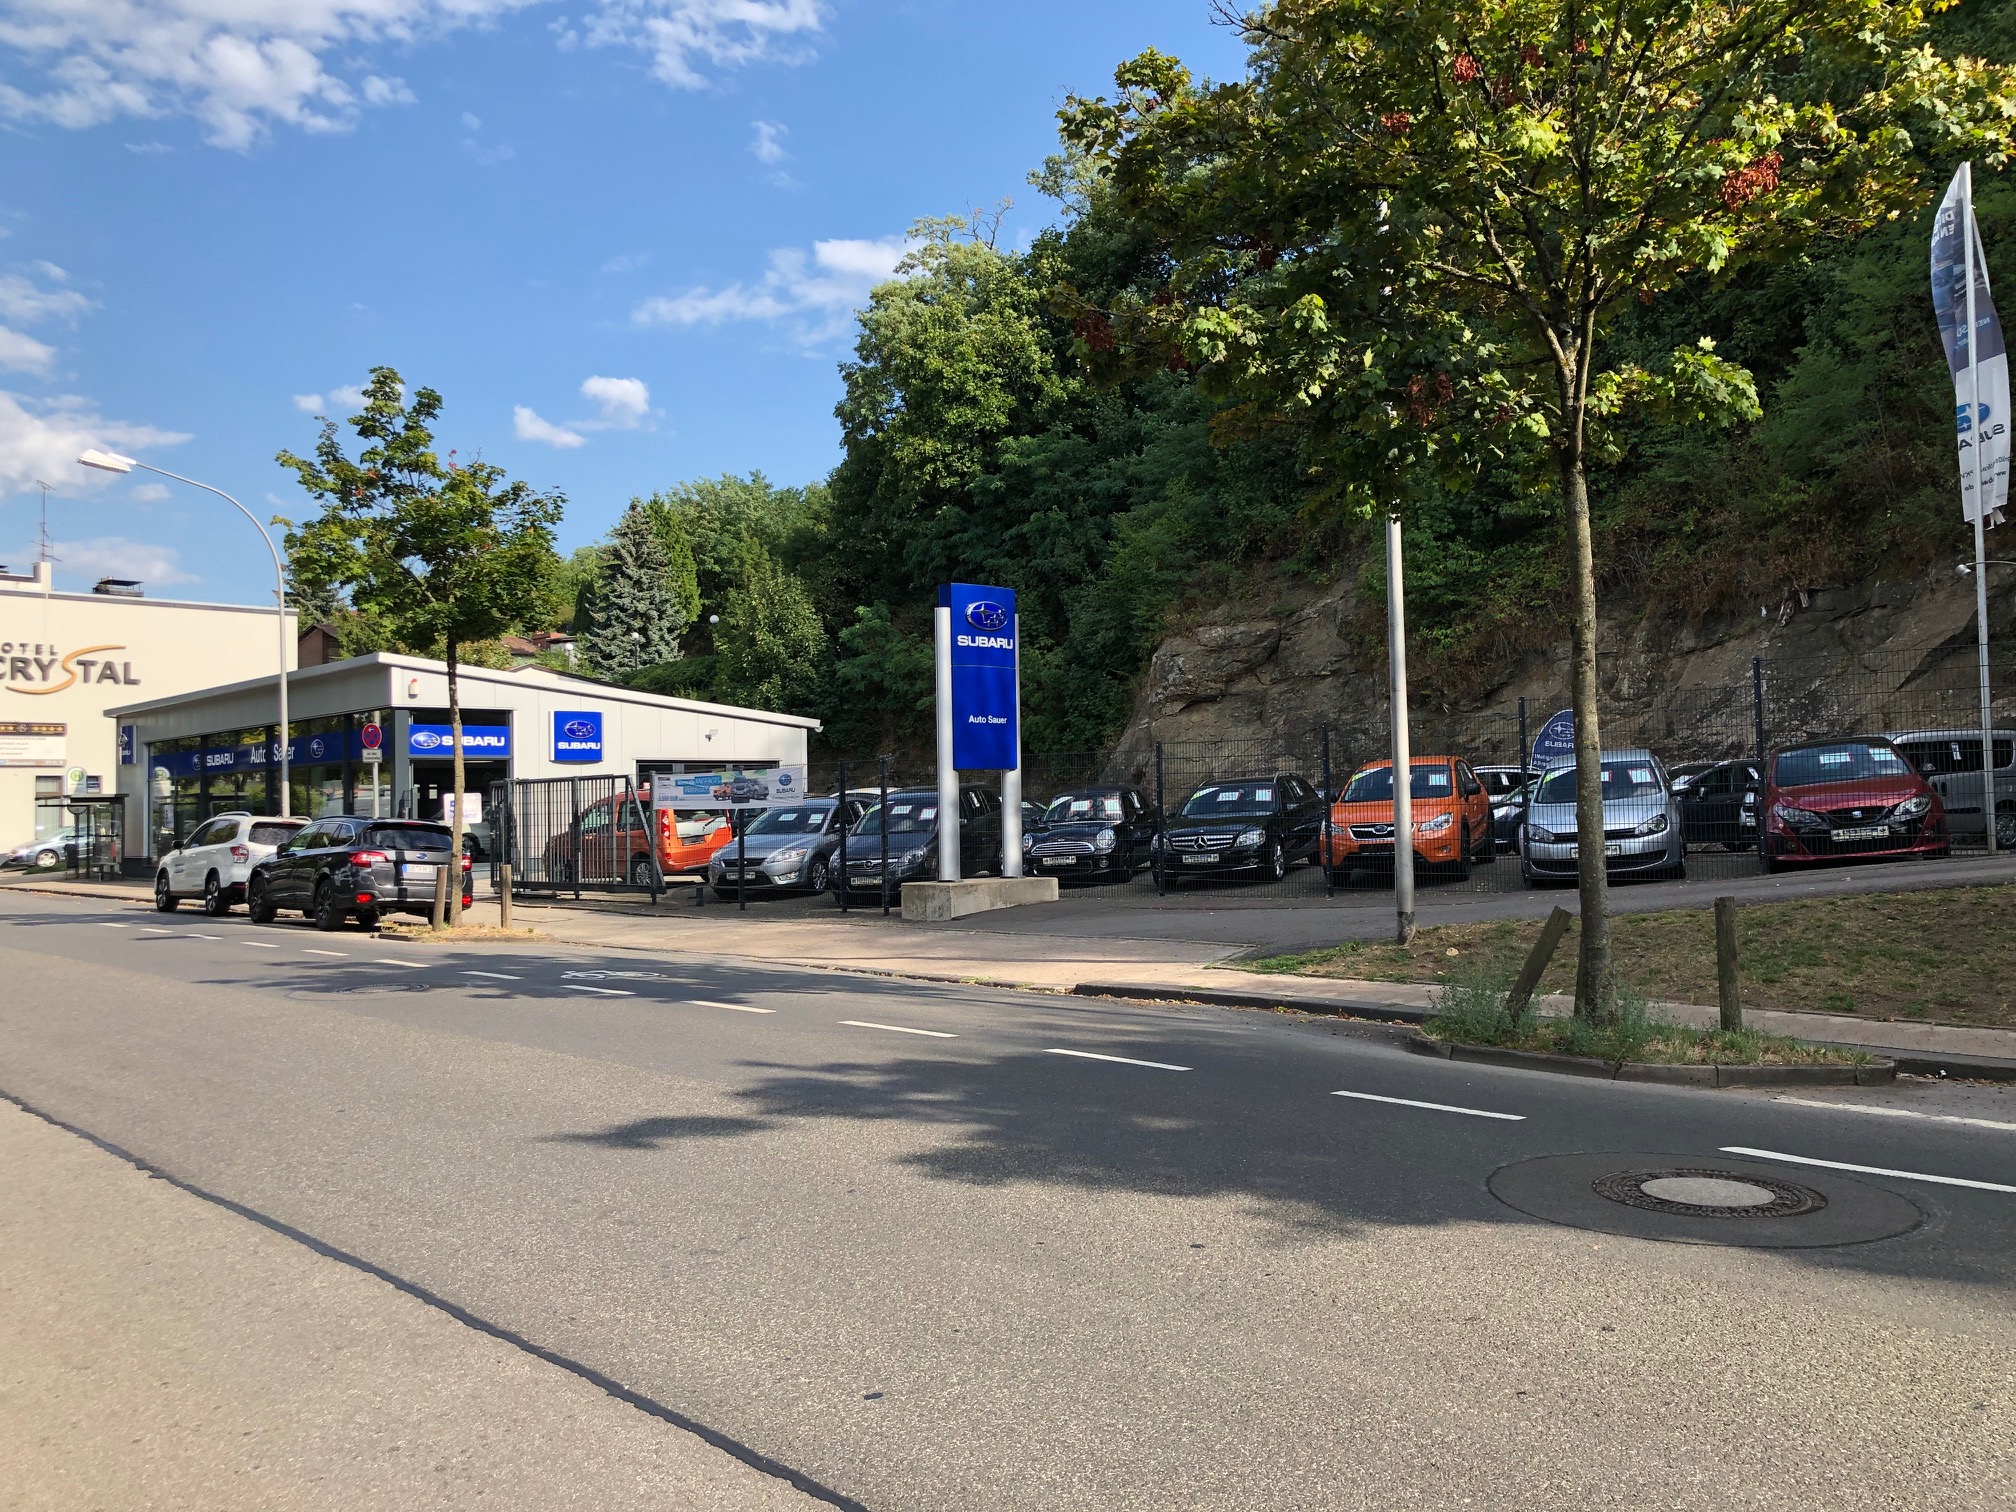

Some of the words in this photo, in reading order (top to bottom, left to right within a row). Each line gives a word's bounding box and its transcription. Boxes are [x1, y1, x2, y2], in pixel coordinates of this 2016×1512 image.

[957, 635, 1014, 650] SUBARU
[1, 642, 59, 656] OTEL
[968, 714, 987, 724] Auto
[987, 715, 1008, 725] Sauer
[557, 741, 601, 750] SUBARU
[1544, 740, 1575, 749] SUBAR
[206, 752, 234, 767] SUBARU
[273, 743, 295, 762] Saer
